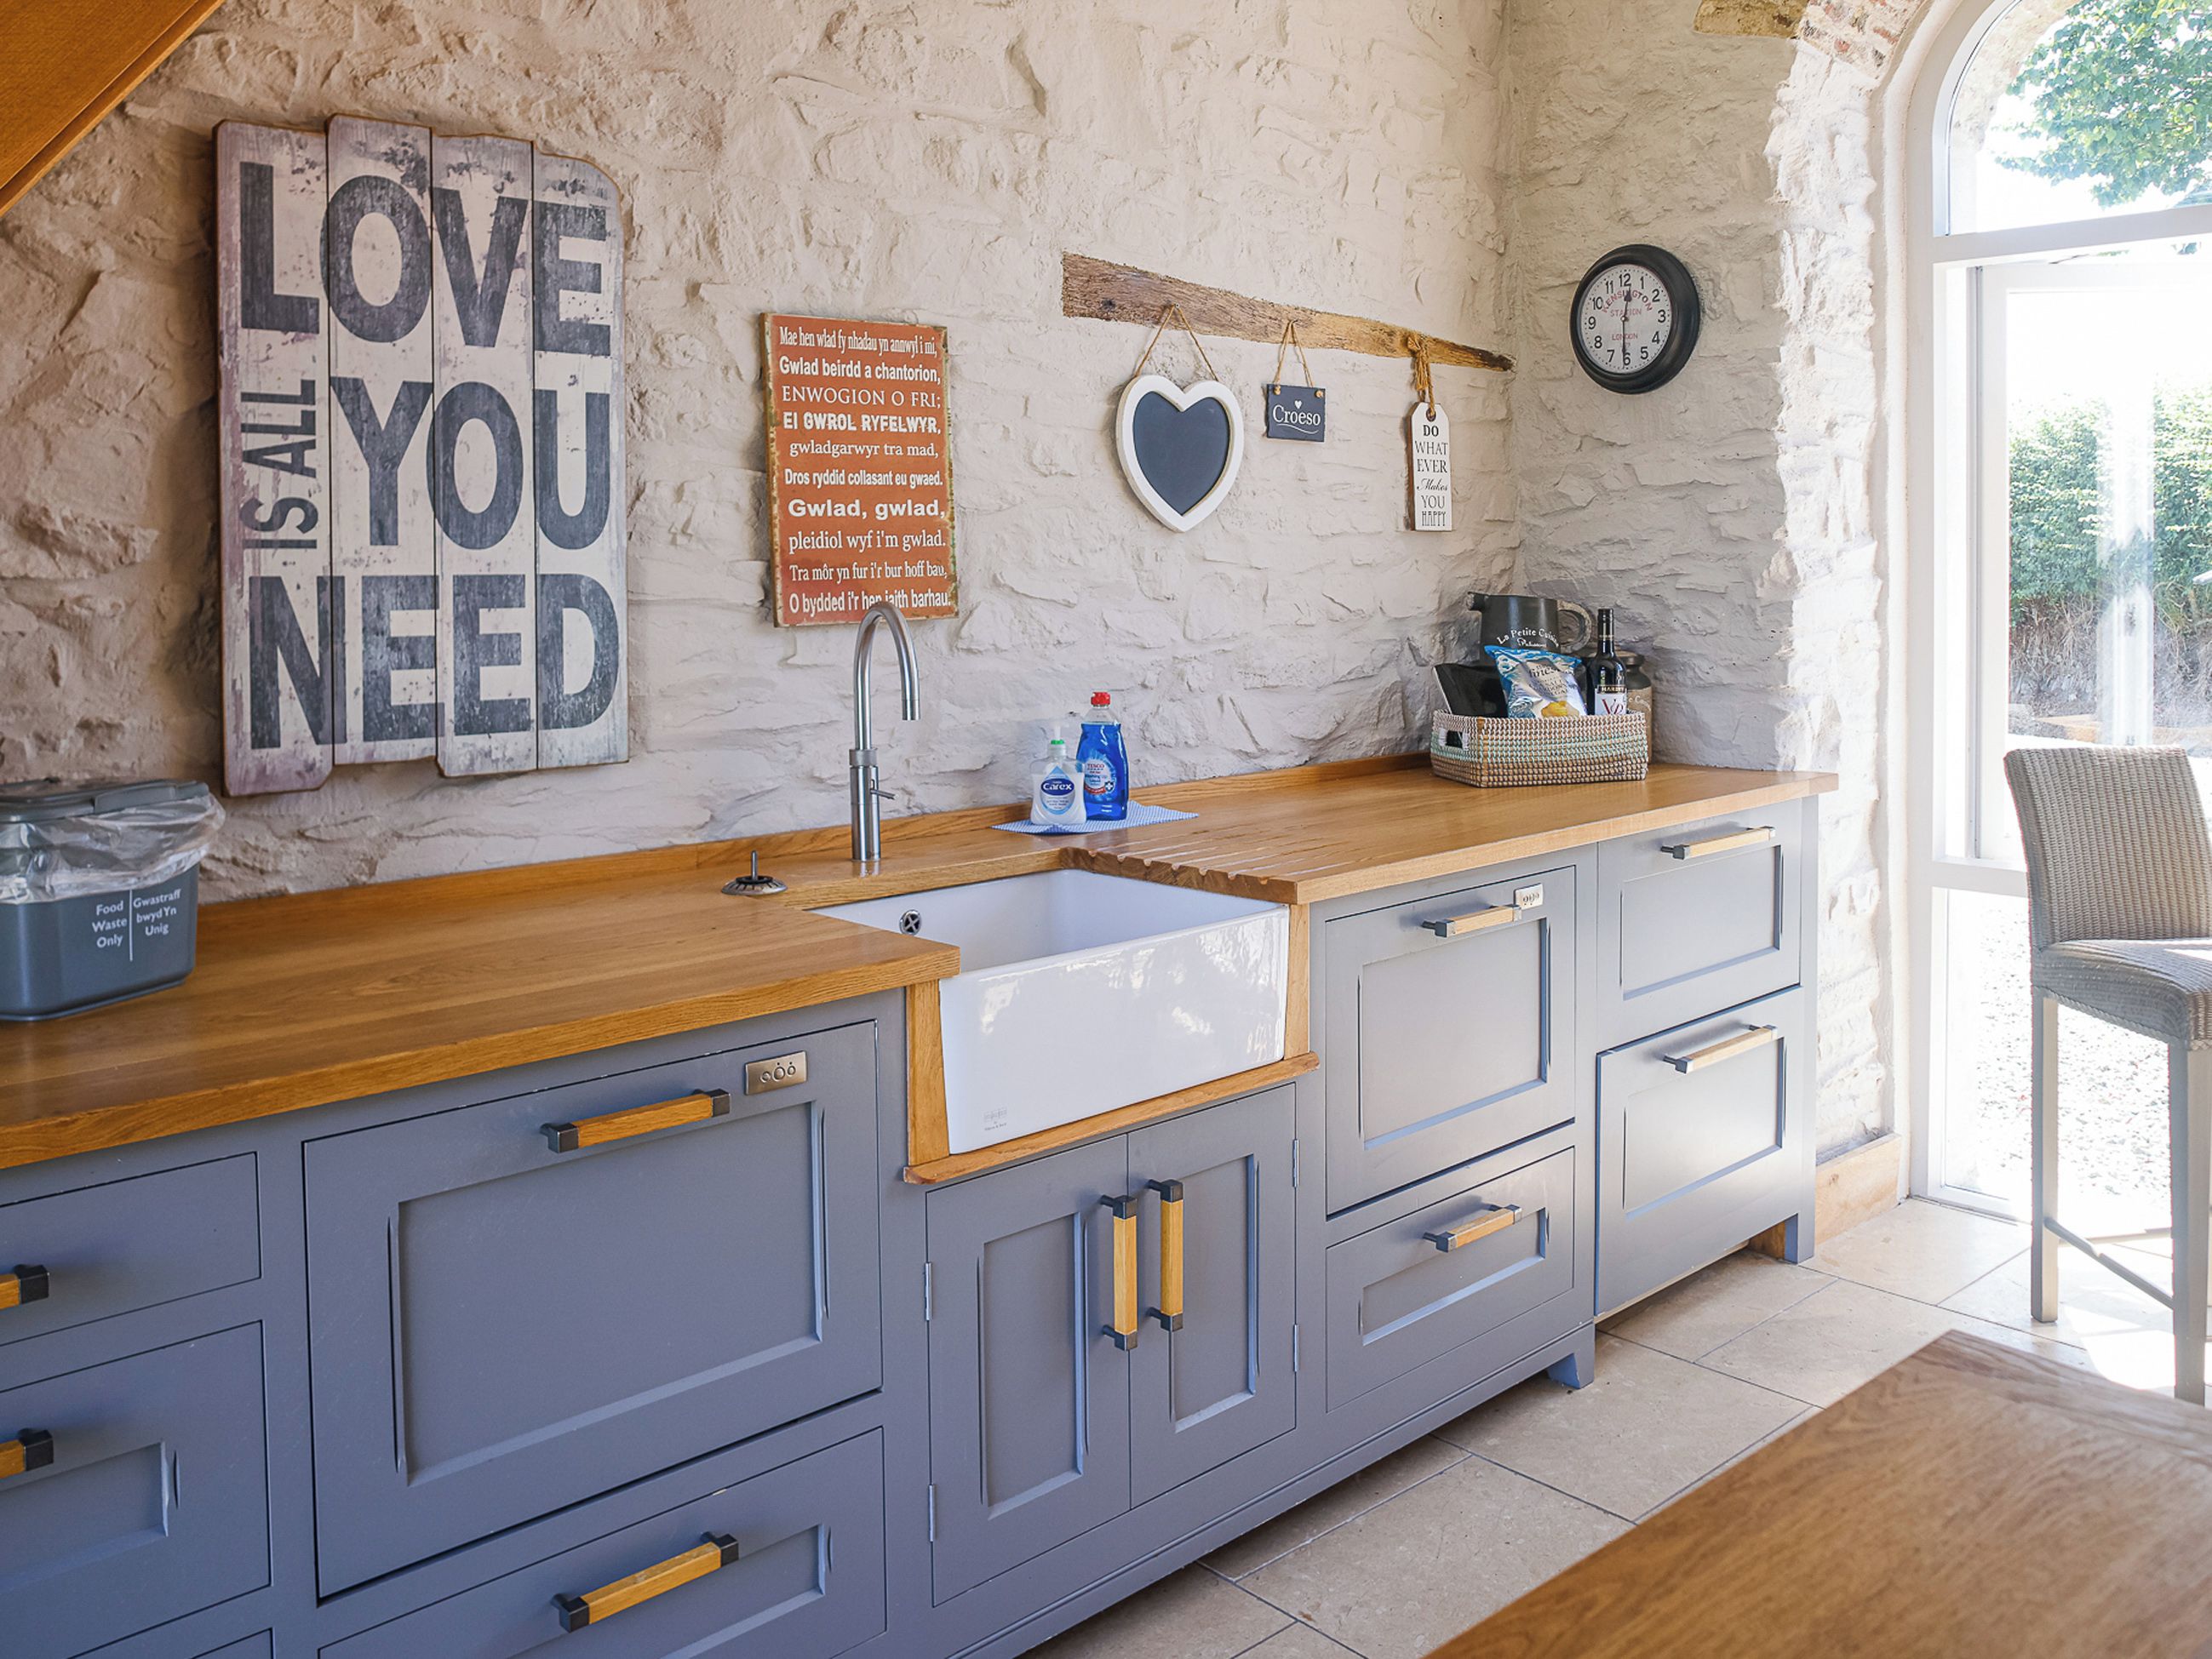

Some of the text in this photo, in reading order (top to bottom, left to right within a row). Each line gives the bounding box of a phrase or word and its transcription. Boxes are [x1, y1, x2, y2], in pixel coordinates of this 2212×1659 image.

[240, 162, 611, 356] LOVE
[1619, 273, 1631, 287] 12
[1641, 277, 1644, 289] 1
[1606, 281, 1613, 294] 11
[1652, 289, 1660, 302] 2
[1592, 297, 1603, 310] 10
[1589, 316, 1596, 329] 9
[1658, 310, 1665, 323] 3
[780, 327, 937, 358] Mae hen wlad fy nhadau yn annwyl i mi,
[1594, 335, 1602, 348] 8
[1652, 331, 1660, 344] 4
[1607, 350, 1614, 362] 7
[1624, 352, 1630, 365] 6
[1641, 346, 1648, 359] 5
[780, 356, 941, 385] Gwlad beirdd a chantorion,
[782, 386, 941, 409] ENWOGION O FRI;
[1272, 404, 1321, 426] Croeso
[783, 412, 941, 434] EI GWROL RYFELWYR,
[1423, 425, 1439, 437] DO
[790, 440, 938, 458] gwladgarwyr tra mad,
[1415, 441, 1448, 455] WHAT
[240, 379, 318, 551] IS ALL
[330, 376, 610, 550] YOU
[1418, 459, 1447, 473] EVER
[784, 468, 943, 489] Dros ryddid collasant eu gwaed.
[1417, 478, 1447, 491] Makes
[1421, 495, 1445, 508] YOU
[788, 499, 945, 520] Gwlad, gwlad,
[1422, 512, 1446, 526] HAPPY
[788, 529, 946, 555] pleidiol wyf i'm gwlad.
[789, 560, 947, 584] Tra môr yn fur i'r bur hoff bau,
[789, 593, 799, 613] O
[803, 592, 845, 616] bydded
[848, 592, 860, 610] i'r
[910, 587, 951, 608] barhau.
[1497, 634, 1510, 644] La
[1510, 627, 1536, 638] Petite
[249, 575, 618, 750] NEED
[133, 890, 181, 908] Gwastraff
[96, 901, 123, 916] Food
[136, 907, 177, 924] bwyd Yn
[92, 918, 127, 933] Waste
[145, 924, 169, 936] Unig
[96, 935, 123, 948] Only
